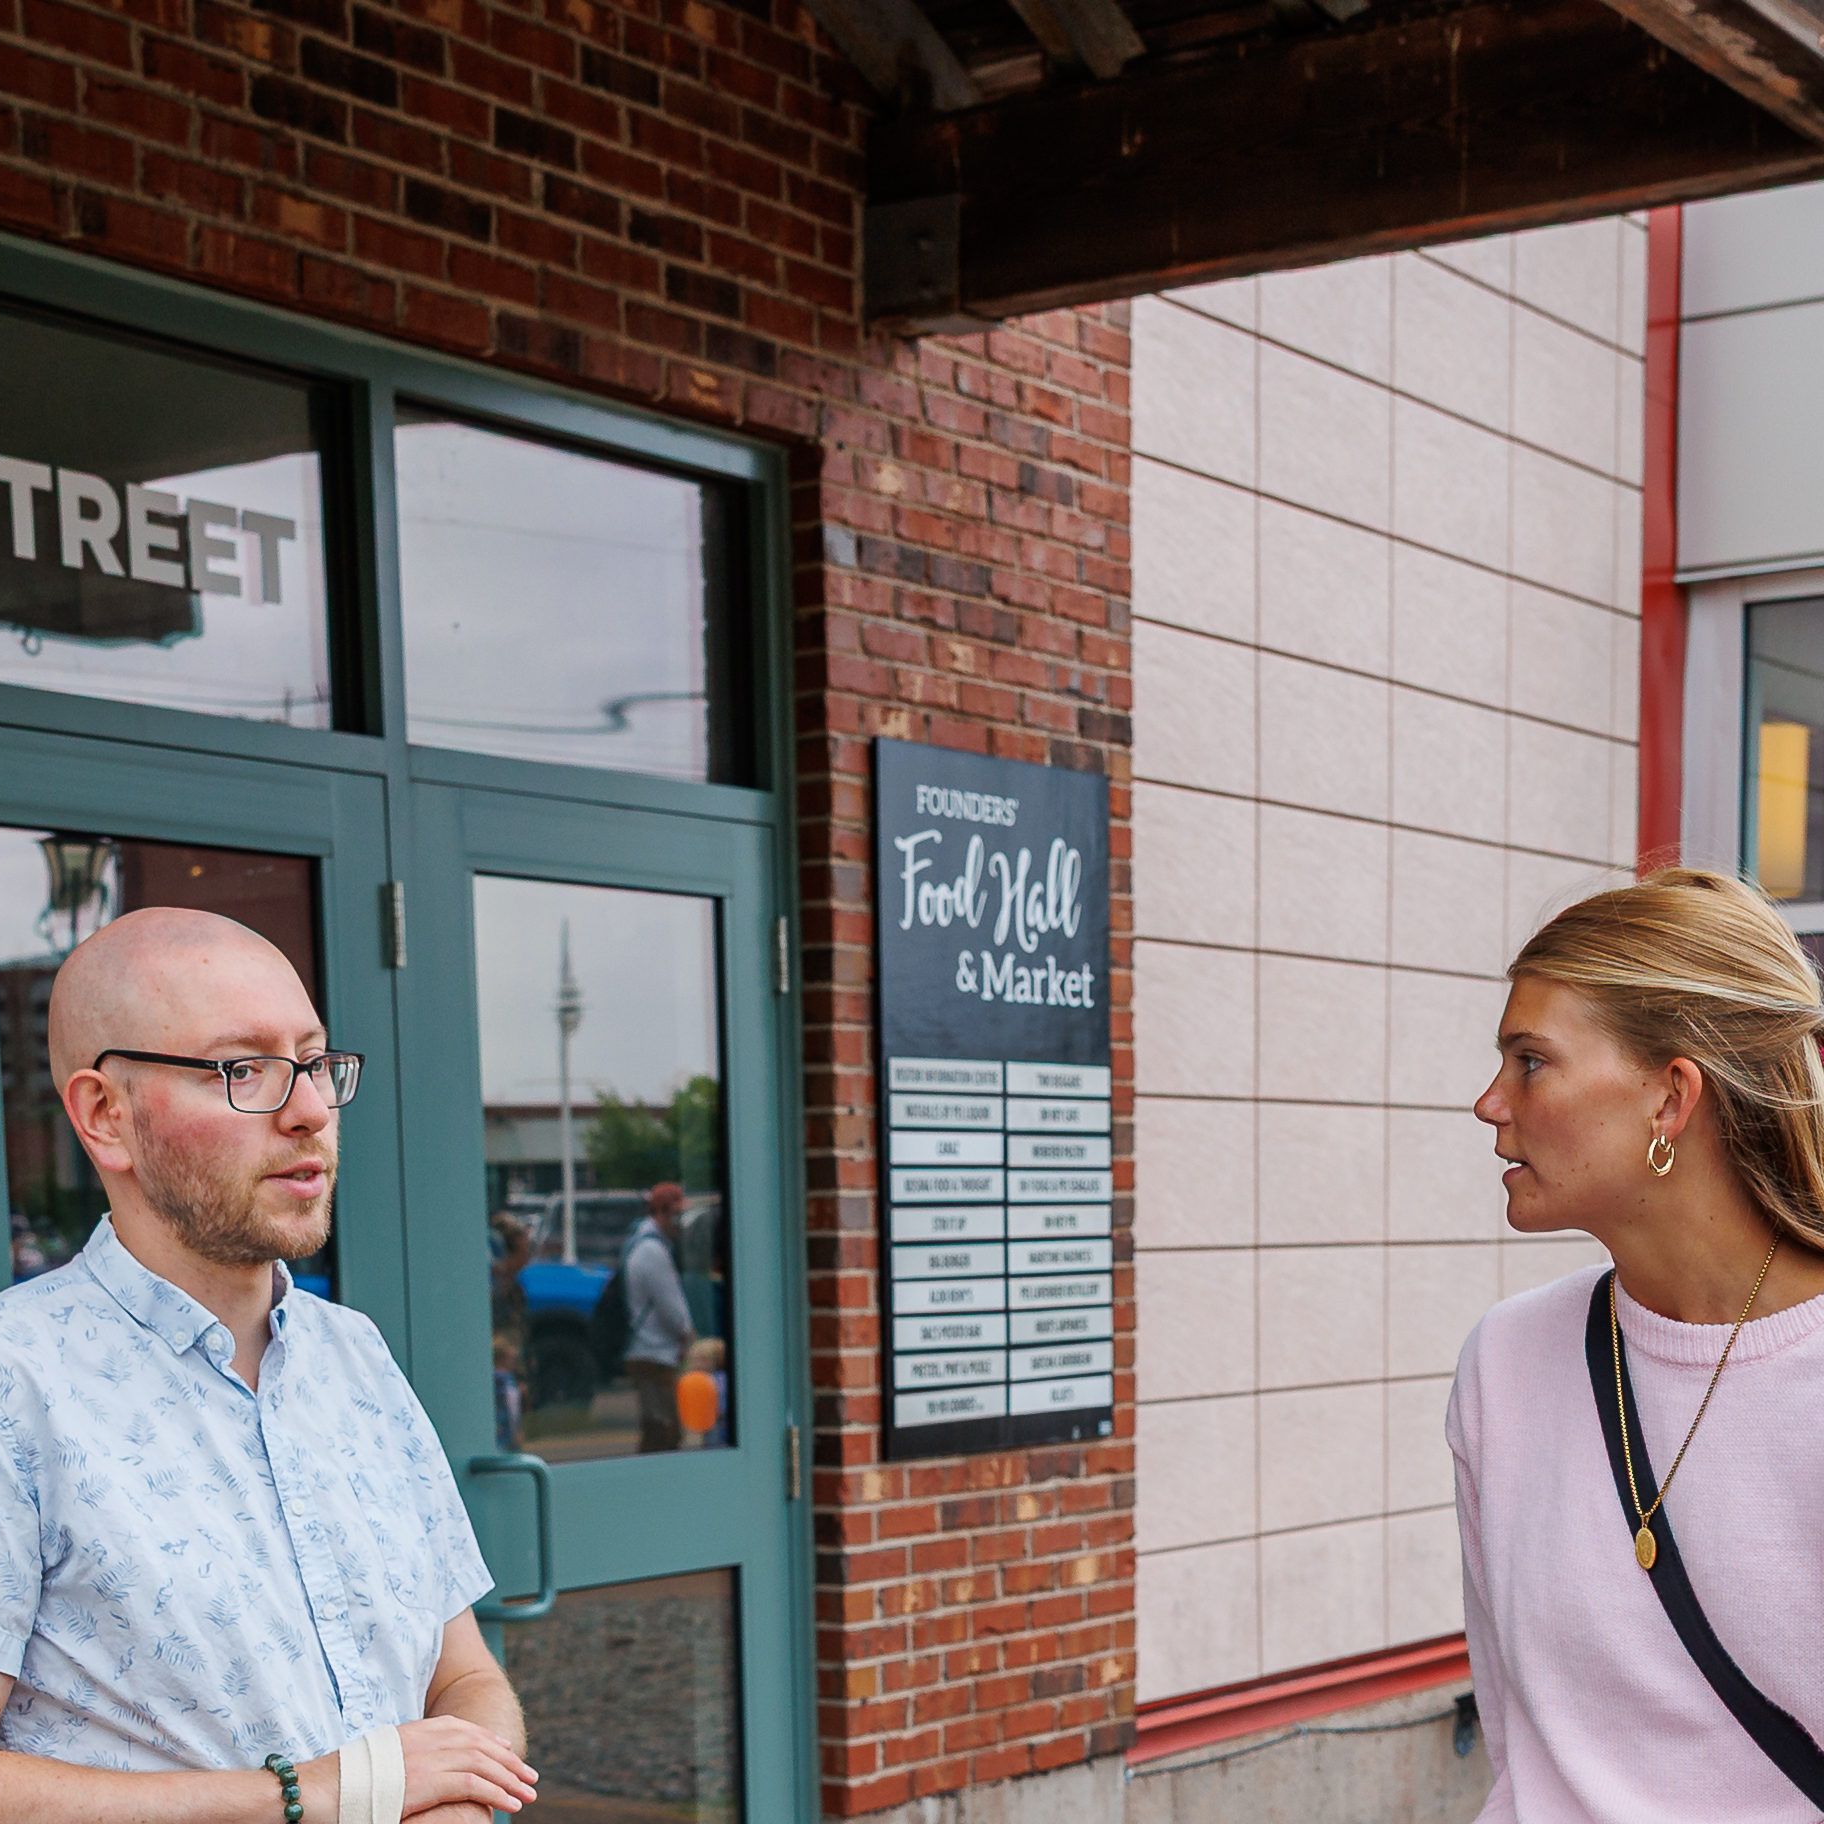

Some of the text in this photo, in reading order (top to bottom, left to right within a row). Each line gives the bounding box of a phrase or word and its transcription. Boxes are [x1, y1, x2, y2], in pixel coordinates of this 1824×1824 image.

[894, 828, 1082, 953] Food Hall
[956, 949, 1095, 1009] & Market
